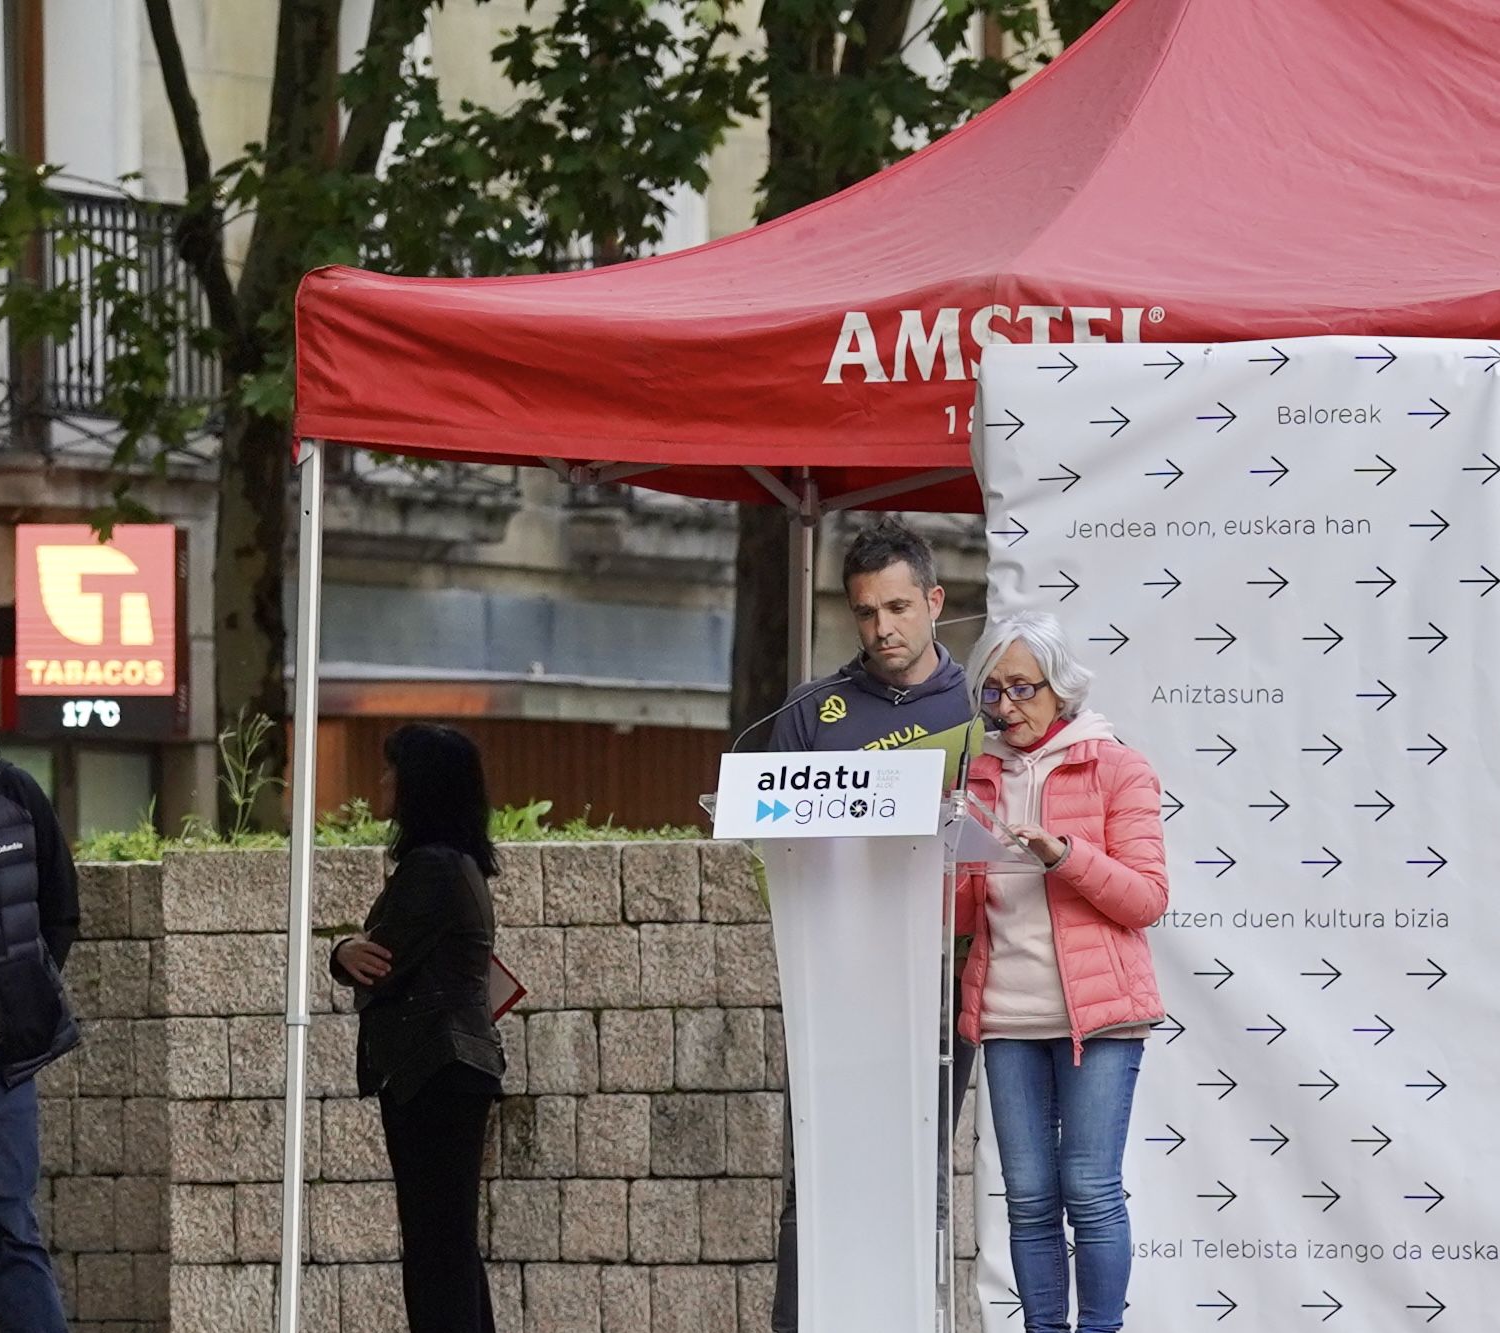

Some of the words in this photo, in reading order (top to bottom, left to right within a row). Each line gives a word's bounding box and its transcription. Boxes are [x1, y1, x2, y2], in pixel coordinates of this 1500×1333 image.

[1277, 403, 1382, 425] Baloreak
[1064, 518, 1157, 539] Jendea
[1166, 518, 1216, 539] non,
[1223, 515, 1316, 536] euskara
[1325, 514, 1371, 535] han
[26, 659, 164, 686] TABACOS
[1151, 684, 1284, 705] Aniztasuna
[757, 765, 870, 791] aldatu
[1232, 908, 1295, 929] duen
[1304, 908, 1385, 929] kultura
[1394, 908, 1449, 929] bizia
[1191, 1238, 1298, 1259] Telebista
[1307, 1238, 1385, 1264] izango
[1392, 1239, 1422, 1260] da
